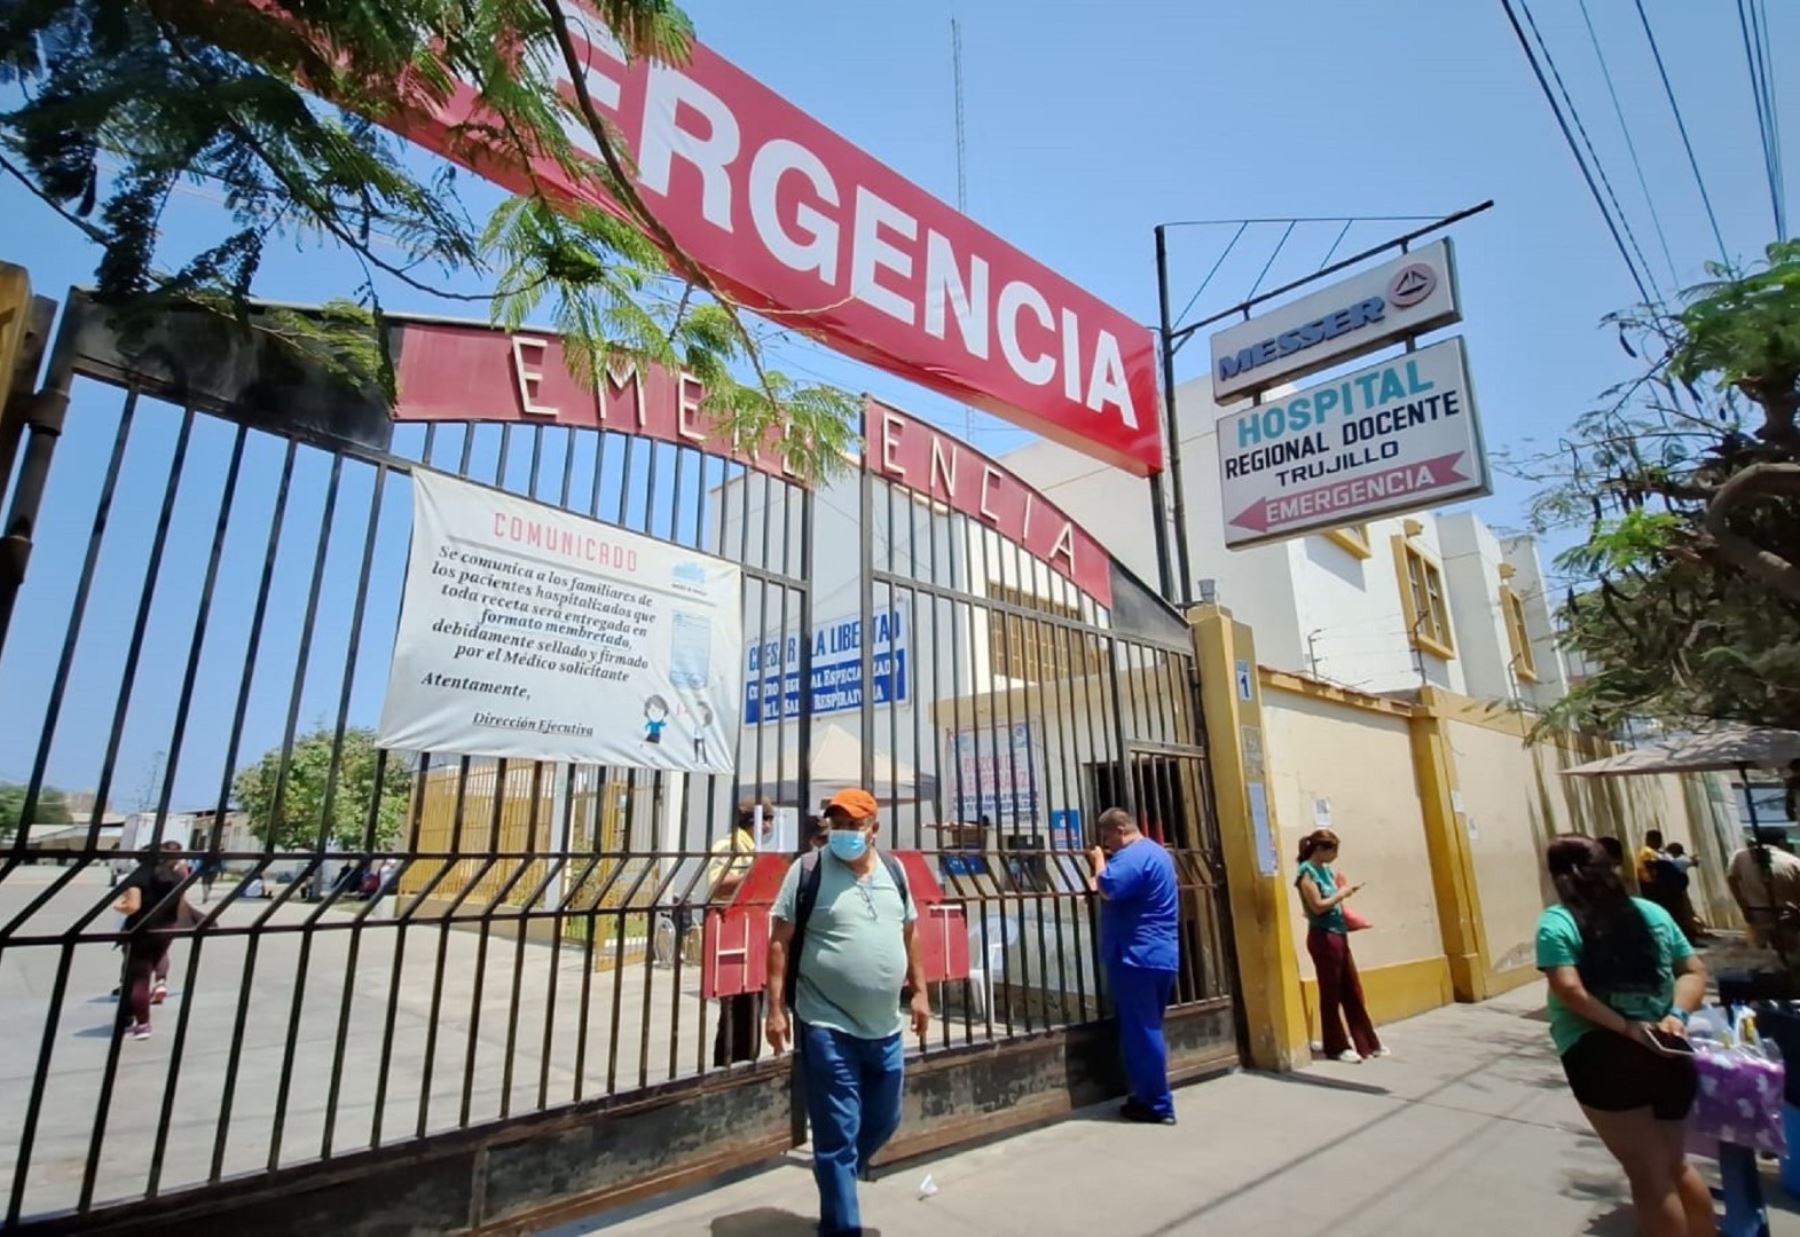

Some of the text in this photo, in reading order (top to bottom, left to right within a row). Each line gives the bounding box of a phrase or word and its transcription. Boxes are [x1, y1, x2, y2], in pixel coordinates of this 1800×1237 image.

[1218, 295, 1386, 382] MESSER
[1236, 359, 1436, 449] HOSPITAL
[1224, 390, 1460, 480] REGIONAL DOCENTE
[1275, 440, 1400, 487] TRUJILLO
[1265, 464, 1436, 524] EMERGENCIA
[494, 512, 637, 572] COMUNICADO
[432, 561, 656, 624] los pacientes hospitalizados que
[438, 545, 653, 608] Se comunica a los familiares de
[441, 584, 479, 602] toda
[481, 594, 529, 613] receta
[564, 612, 631, 634] entregada
[632, 626, 648, 638] en
[478, 608, 632, 650] formato membretado,
[432, 618, 649, 669] debidamente sellado y firmado
[453, 644, 630, 682] por el Médico solicitante
[421, 671, 531, 700] Atentamente,
[1240, 674, 1250, 699] 1
[472, 711, 537, 731] Dirección
